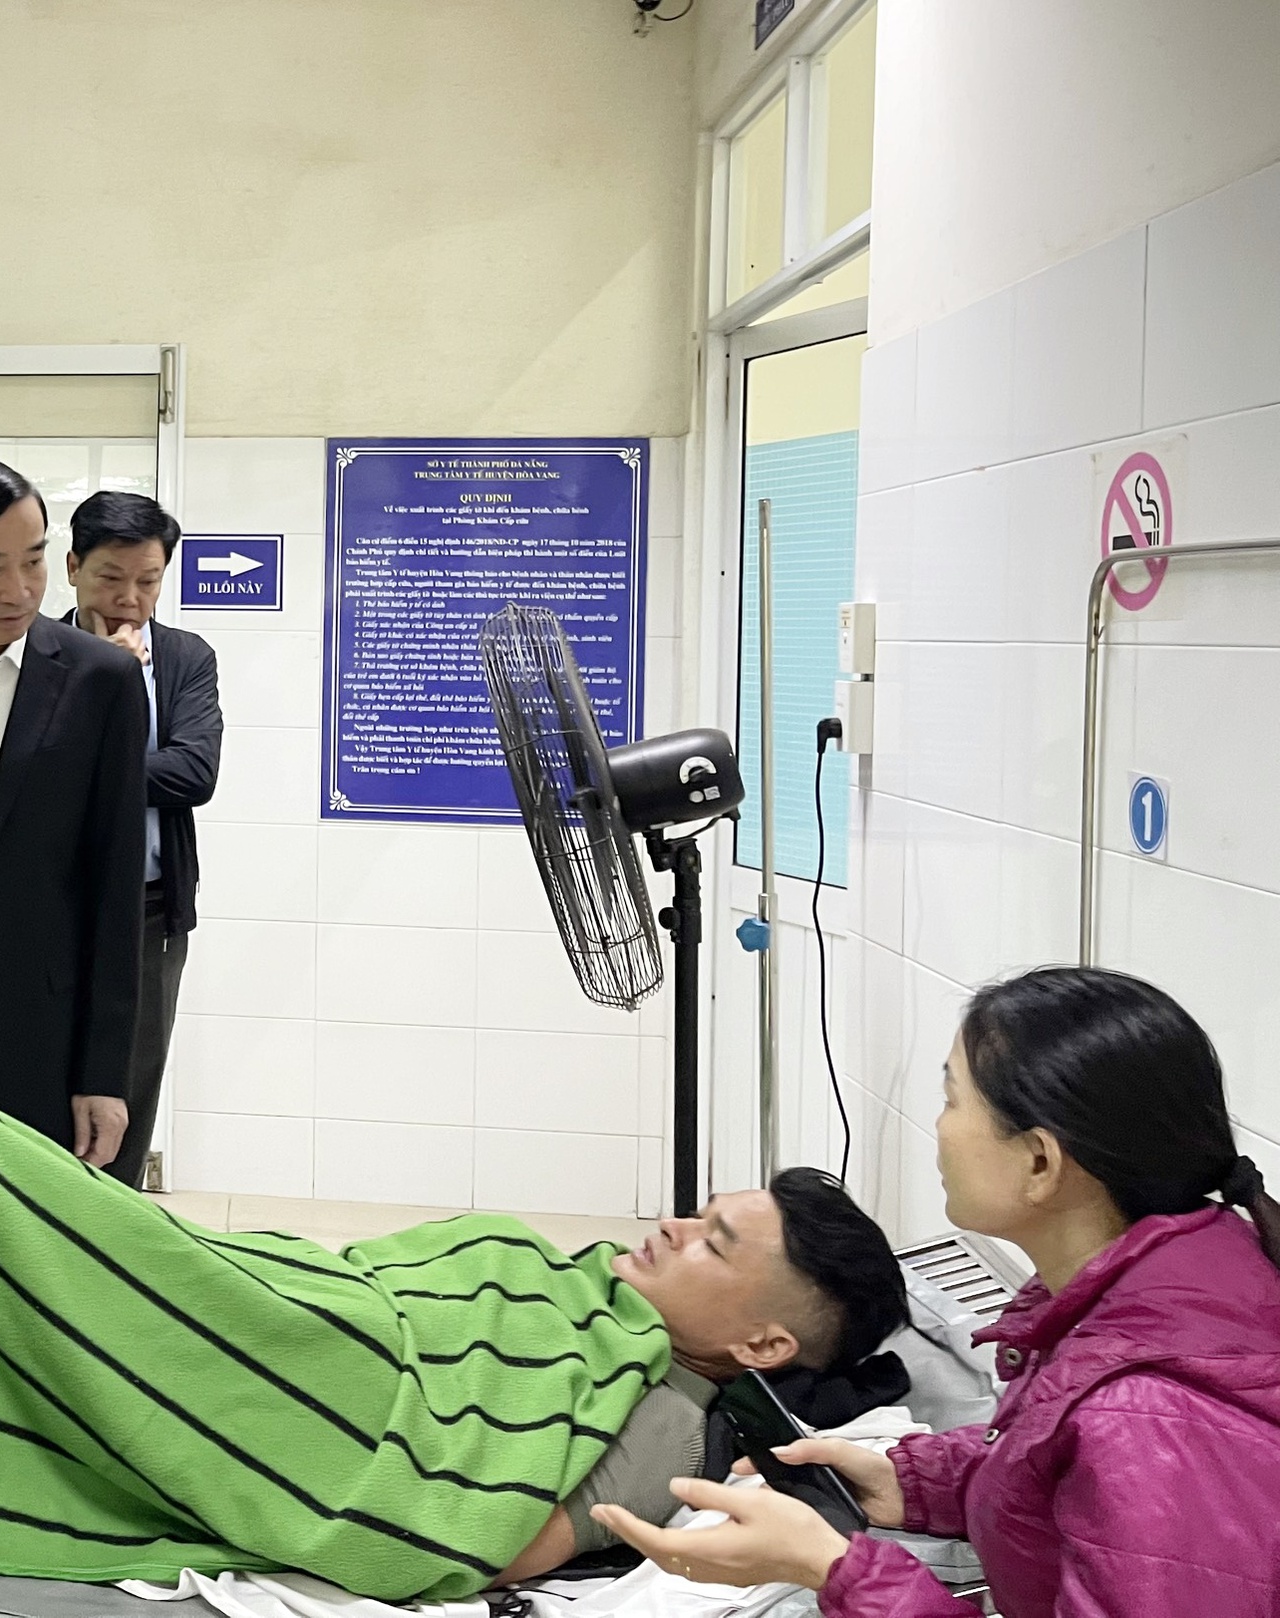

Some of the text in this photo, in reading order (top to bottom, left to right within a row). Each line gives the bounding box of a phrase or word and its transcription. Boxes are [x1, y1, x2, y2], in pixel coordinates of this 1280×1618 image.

[459, 494, 482, 503] QUY
[237, 580, 263, 594] NÀY
[1141, 790, 1154, 842] 1
